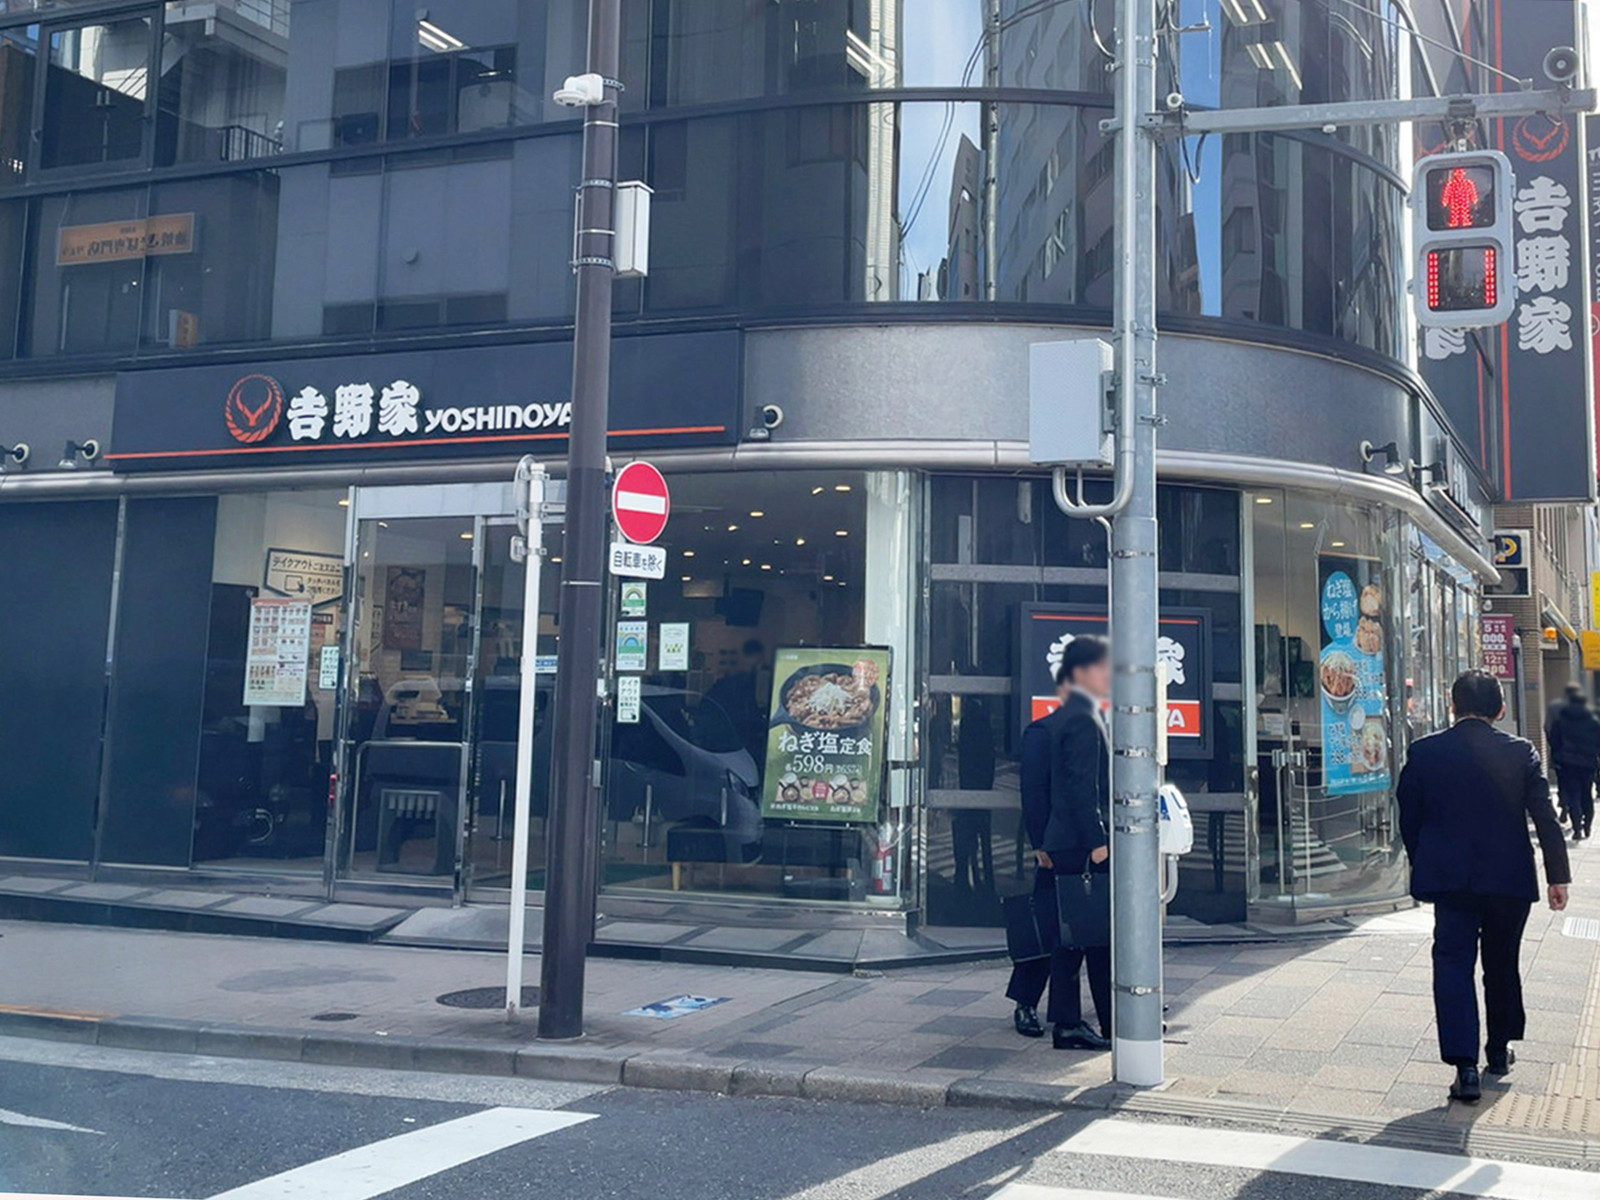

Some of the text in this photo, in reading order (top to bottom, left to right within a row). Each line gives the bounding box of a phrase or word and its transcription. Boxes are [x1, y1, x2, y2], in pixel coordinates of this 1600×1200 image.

[1514, 175, 1573, 354] 吉野家
[286, 379, 421, 440] 吉野家
[424, 401, 572, 433] YOSHINOYA
[613, 550, 662, 572] 自転車を除く
[778, 731, 873, 756] ねぎ塩定食
